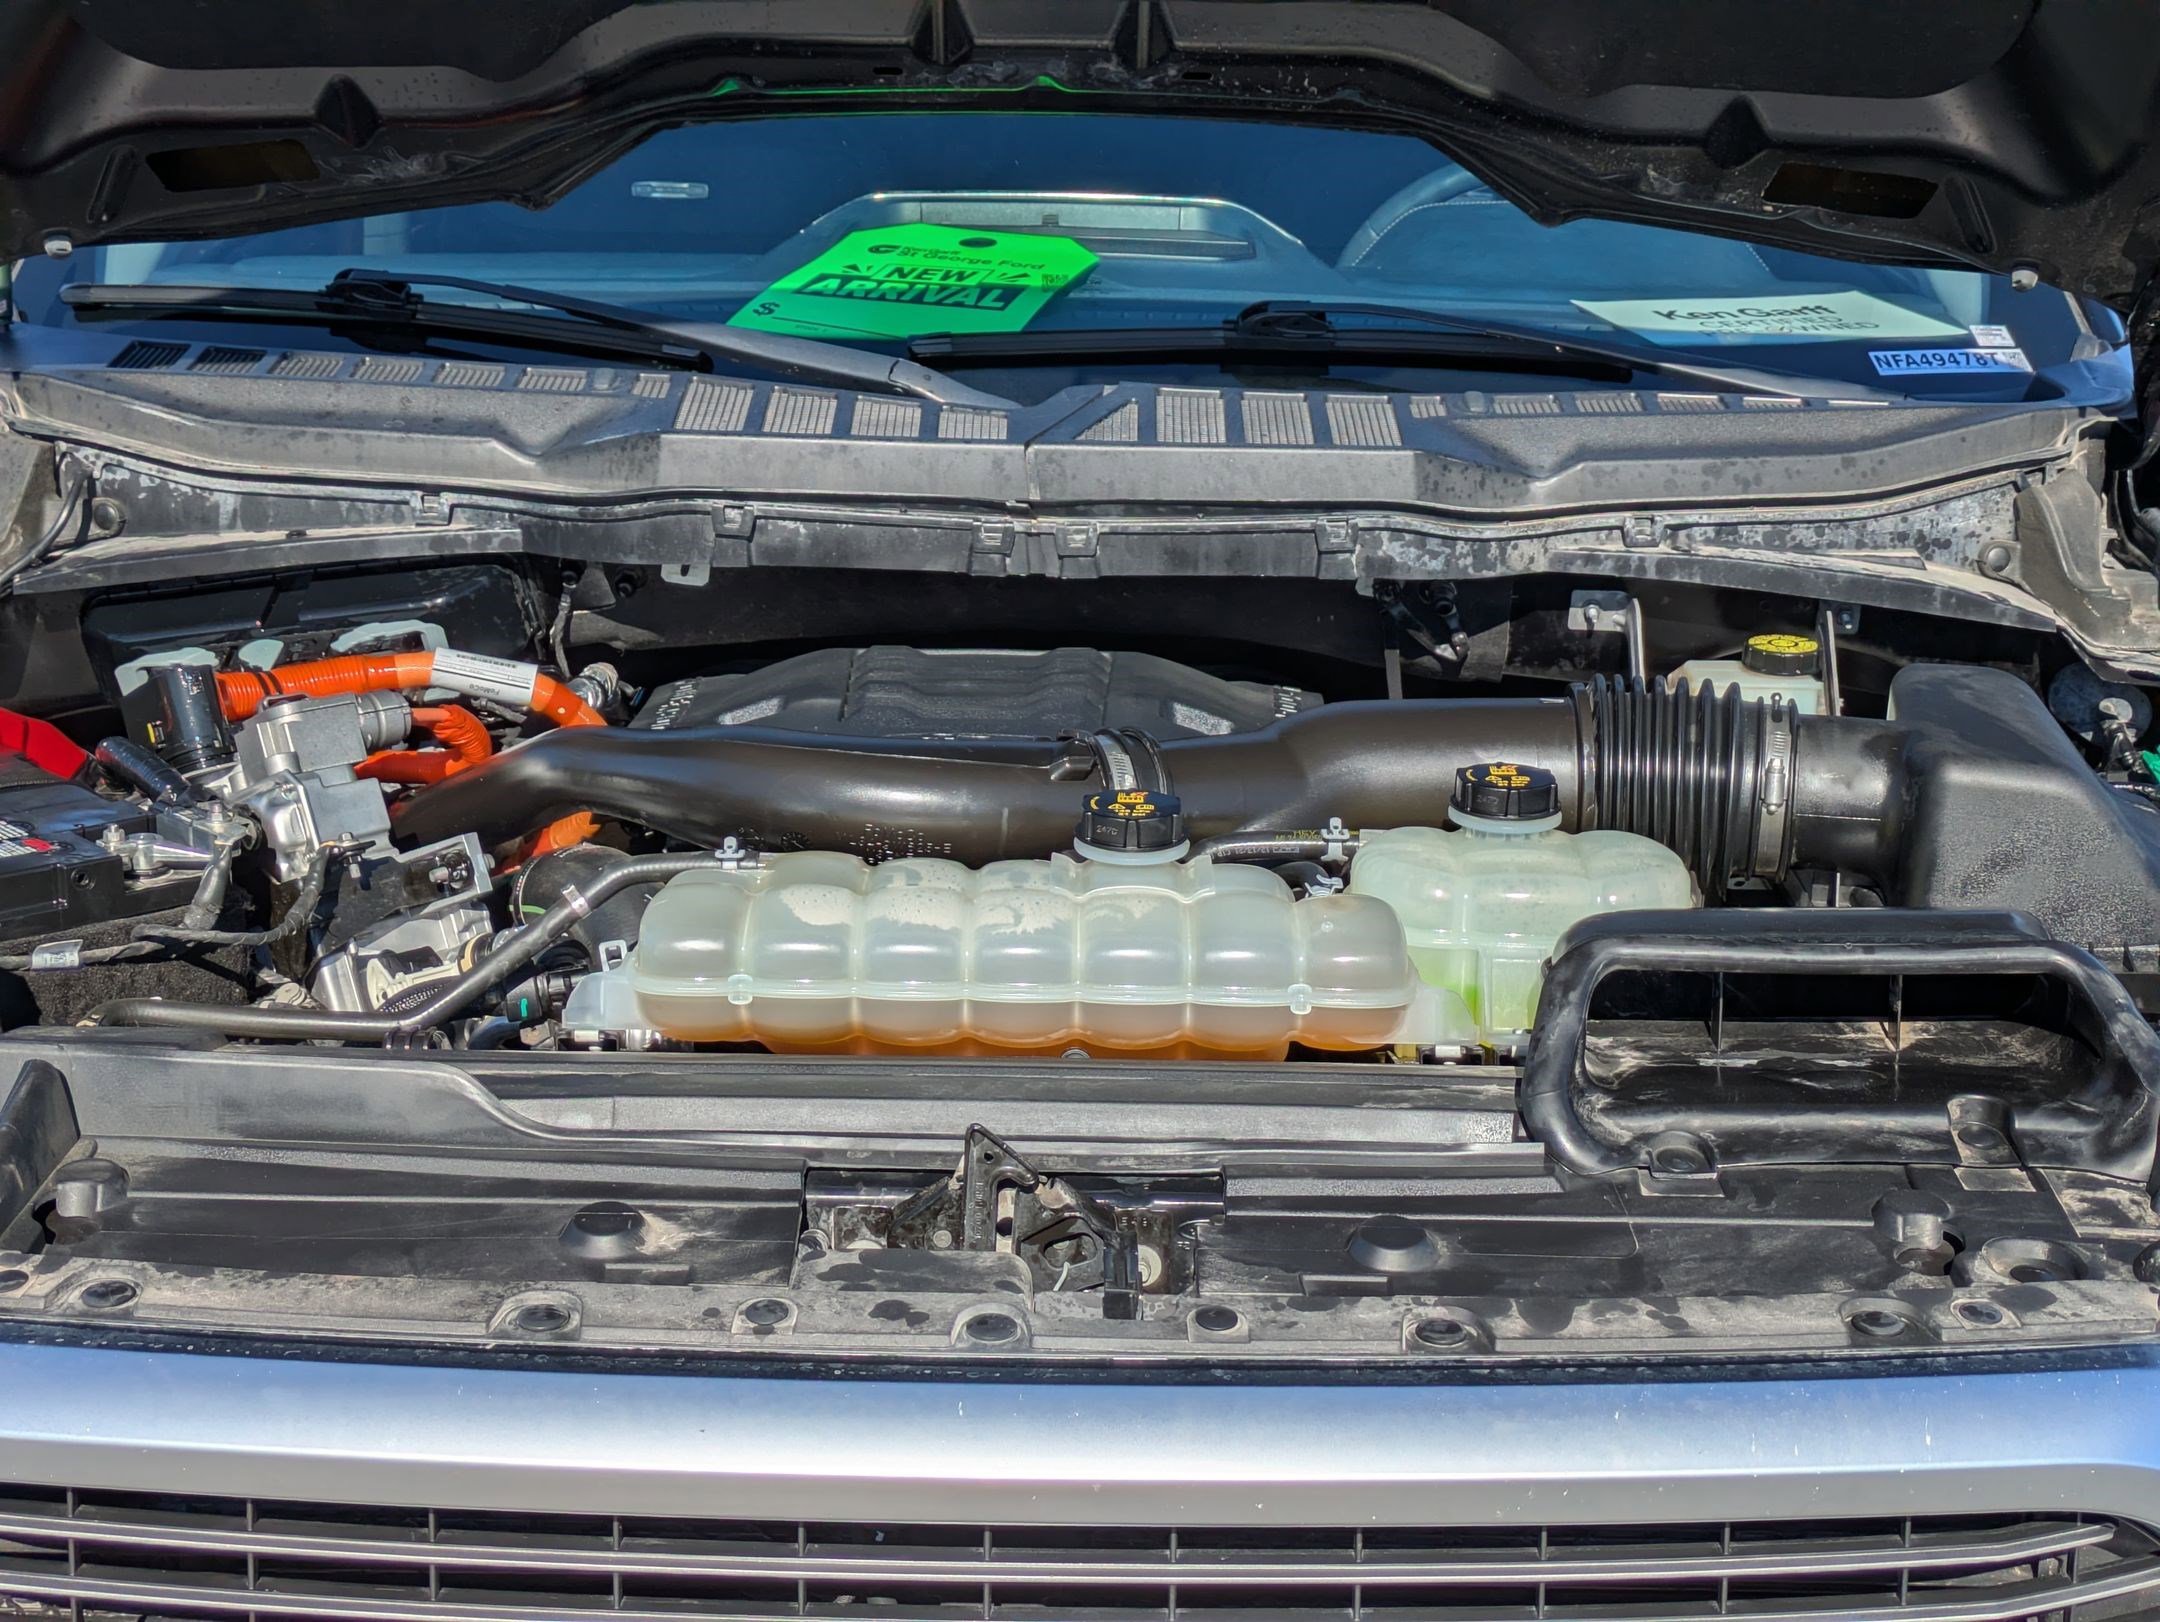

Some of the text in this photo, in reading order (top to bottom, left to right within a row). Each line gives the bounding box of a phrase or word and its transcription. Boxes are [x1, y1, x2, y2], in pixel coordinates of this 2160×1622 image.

[997, 260, 1046, 270] Ford
[884, 266, 979, 283] NEW
[801, 277, 1006, 309] ARRIVAL
[752, 301, 781, 317] $
[1873, 351, 1999, 369] NFA49478T
